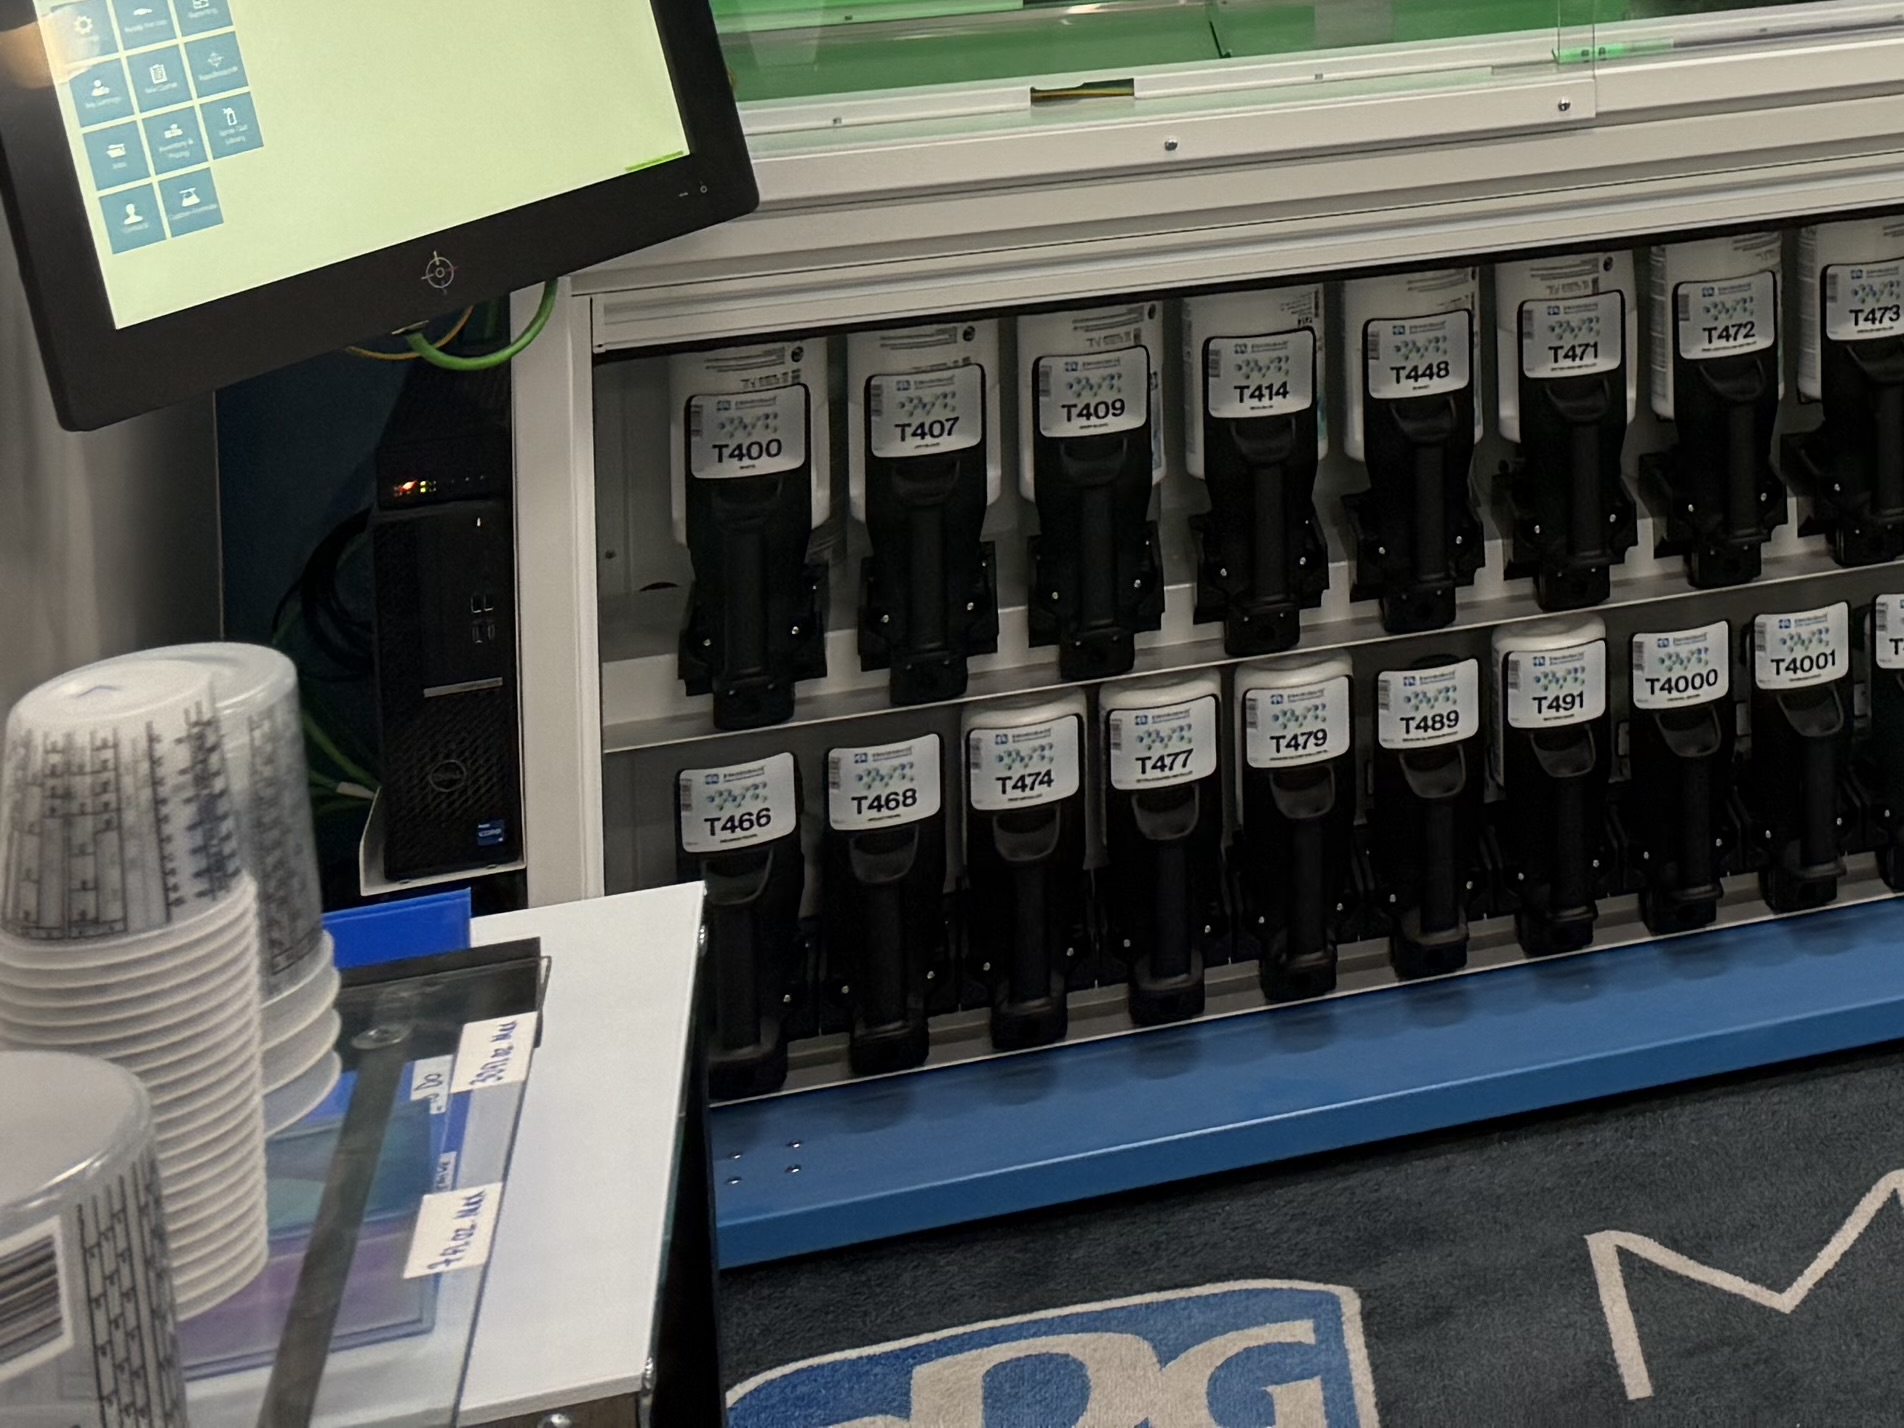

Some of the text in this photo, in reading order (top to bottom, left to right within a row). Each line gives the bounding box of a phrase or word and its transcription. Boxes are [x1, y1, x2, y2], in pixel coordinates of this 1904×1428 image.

[1849, 304, 1901, 327] T473
[1702, 322, 1756, 345] T472
[1548, 341, 1599, 365] T471
[1390, 361, 1450, 385] T448
[1234, 383, 1289, 404] T414
[1061, 398, 1126, 423] T409
[894, 416, 960, 442] T407
[712, 438, 783, 464] T400
[1770, 650, 1837, 677] T4001
[1645, 668, 1719, 696] T4000
[1532, 691, 1584, 715] T491
[1400, 709, 1460, 736] T489
[1269, 728, 1327, 755] T479
[1135, 748, 1194, 776] T477
[995, 768, 1054, 795] T474
[851, 788, 918, 816] T468
[704, 807, 772, 837] T466
